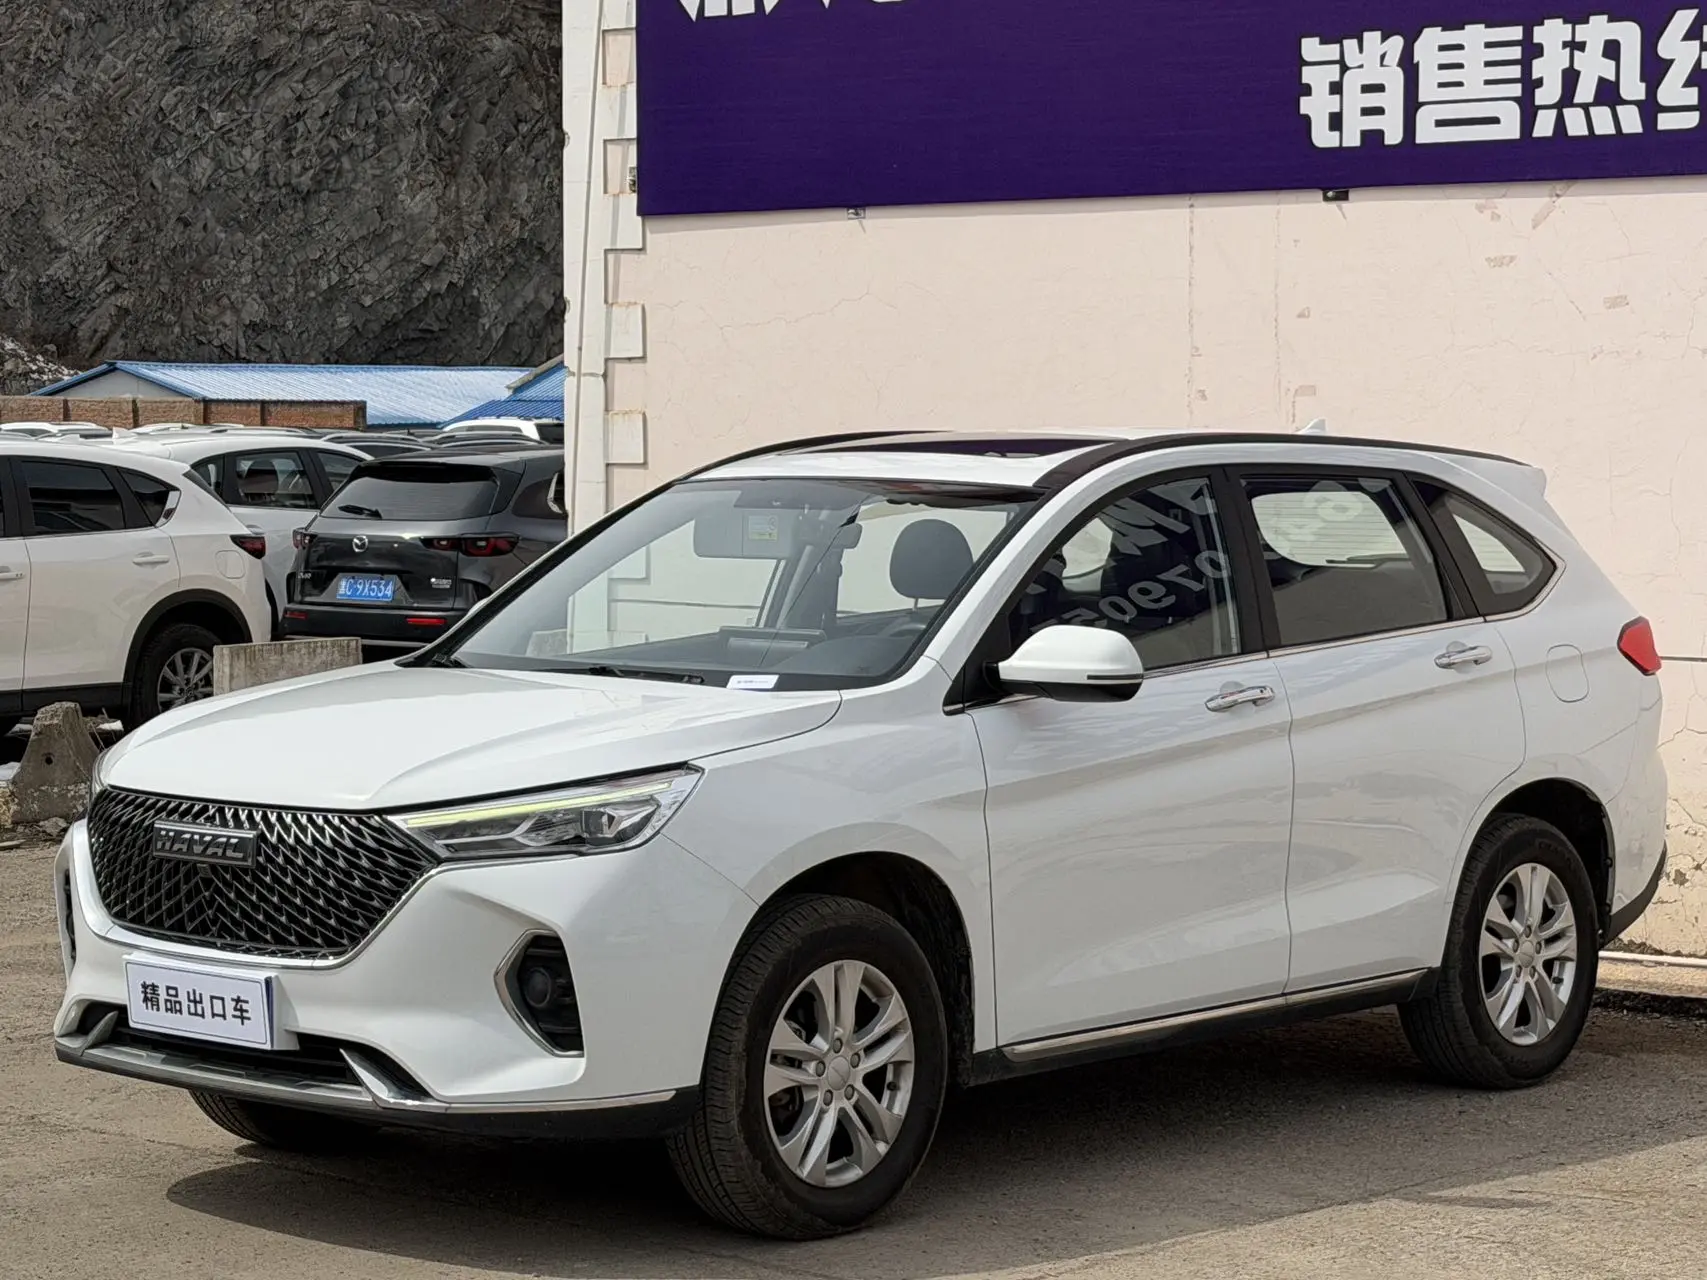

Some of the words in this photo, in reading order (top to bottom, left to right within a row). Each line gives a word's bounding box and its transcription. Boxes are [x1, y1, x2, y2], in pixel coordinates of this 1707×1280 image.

[157, 830, 244, 858] HAVAL
[140, 981, 252, 1026] 精品出口车
